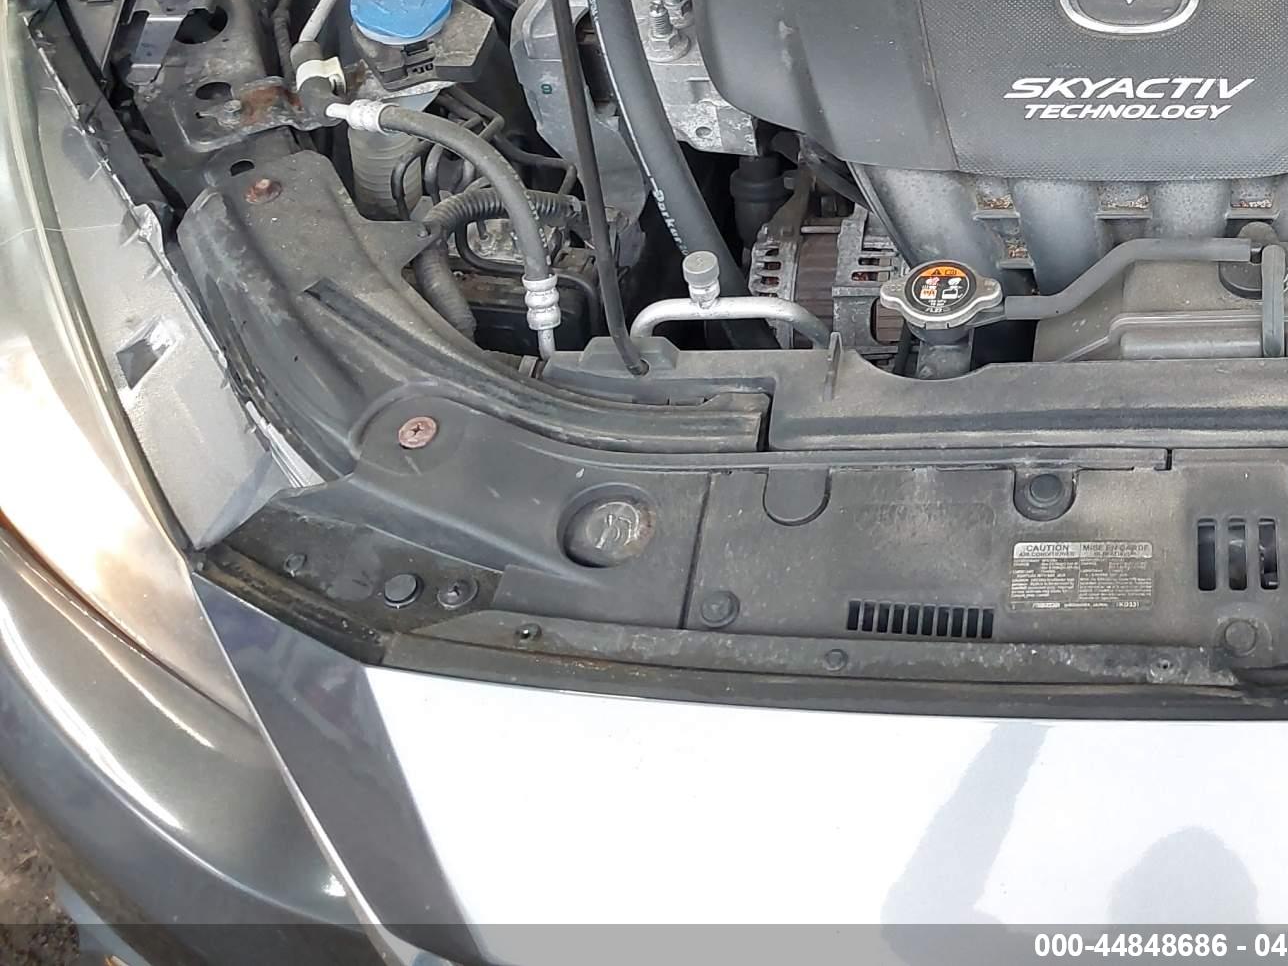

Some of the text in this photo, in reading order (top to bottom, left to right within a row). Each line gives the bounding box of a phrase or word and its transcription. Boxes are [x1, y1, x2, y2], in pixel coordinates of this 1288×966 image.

[1004, 77, 1254, 99] SKYACTIV
[1024, 104, 1231, 120] TECHNOLOGY
[1026, 544, 1069, 552] CAUTION
